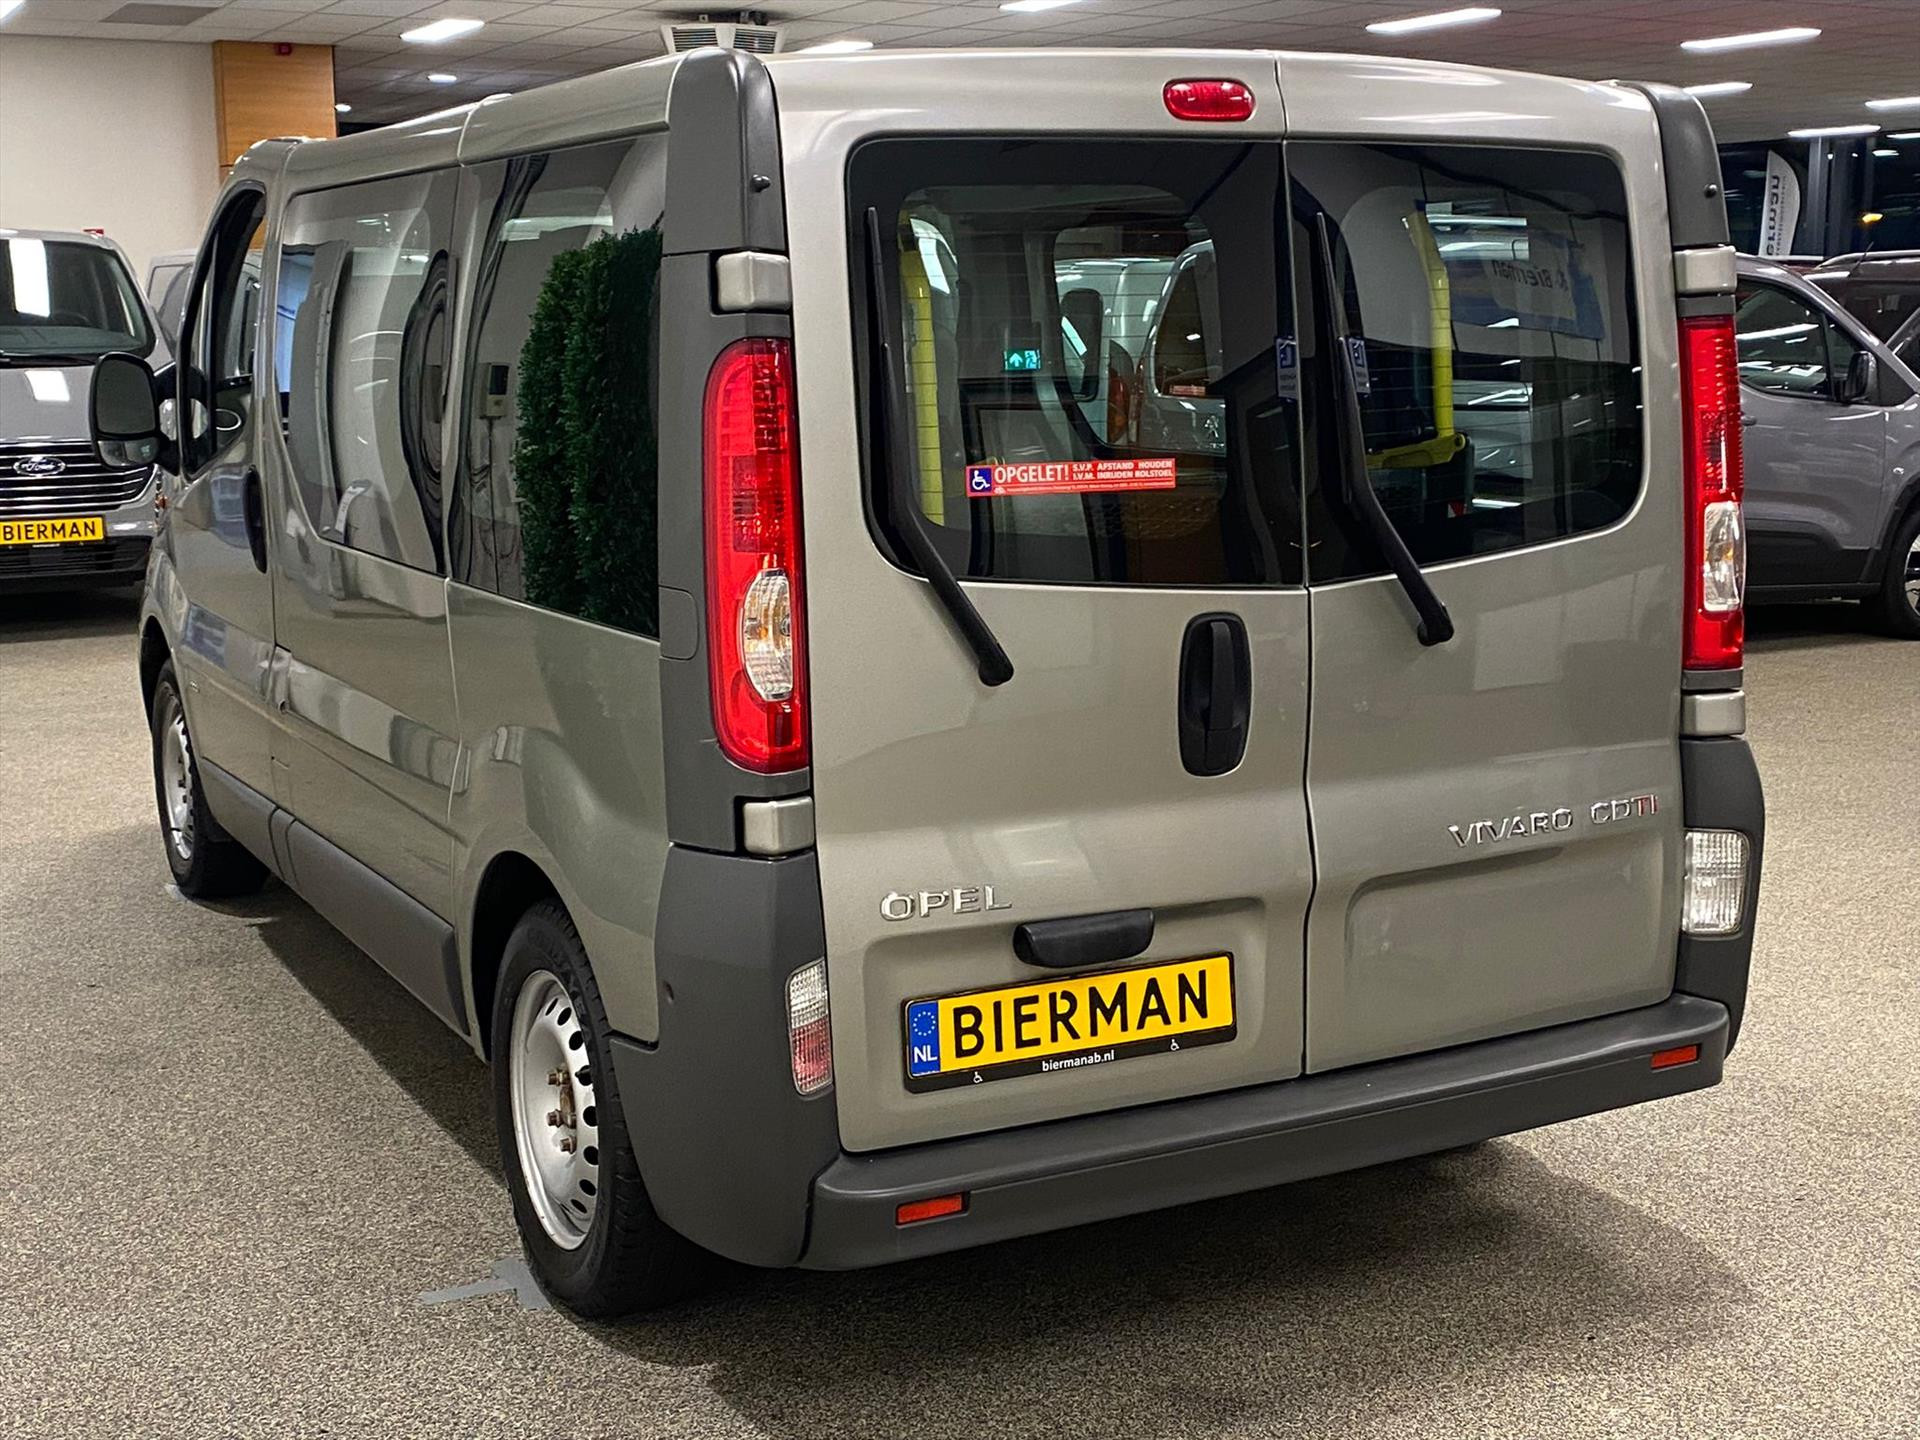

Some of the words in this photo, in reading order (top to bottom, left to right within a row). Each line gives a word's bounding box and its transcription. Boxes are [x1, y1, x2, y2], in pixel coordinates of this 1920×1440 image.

[994, 464, 1070, 483] OPGELET!
[1097, 461, 1134, 471] AFSTAND
[1138, 461, 1173, 469] HOUDEN
[1135, 469, 1174, 478] ROLSTOEL
[2, 520, 97, 541] BIERMAN
[1448, 807, 1573, 847] VIVARO
[1591, 794, 1658, 823] CDTI
[880, 885, 1013, 921] OPEL
[953, 969, 1208, 1059] BIERMAN
[913, 1045, 938, 1064] NL
[1041, 1050, 1116, 1072] biermanab.nl
